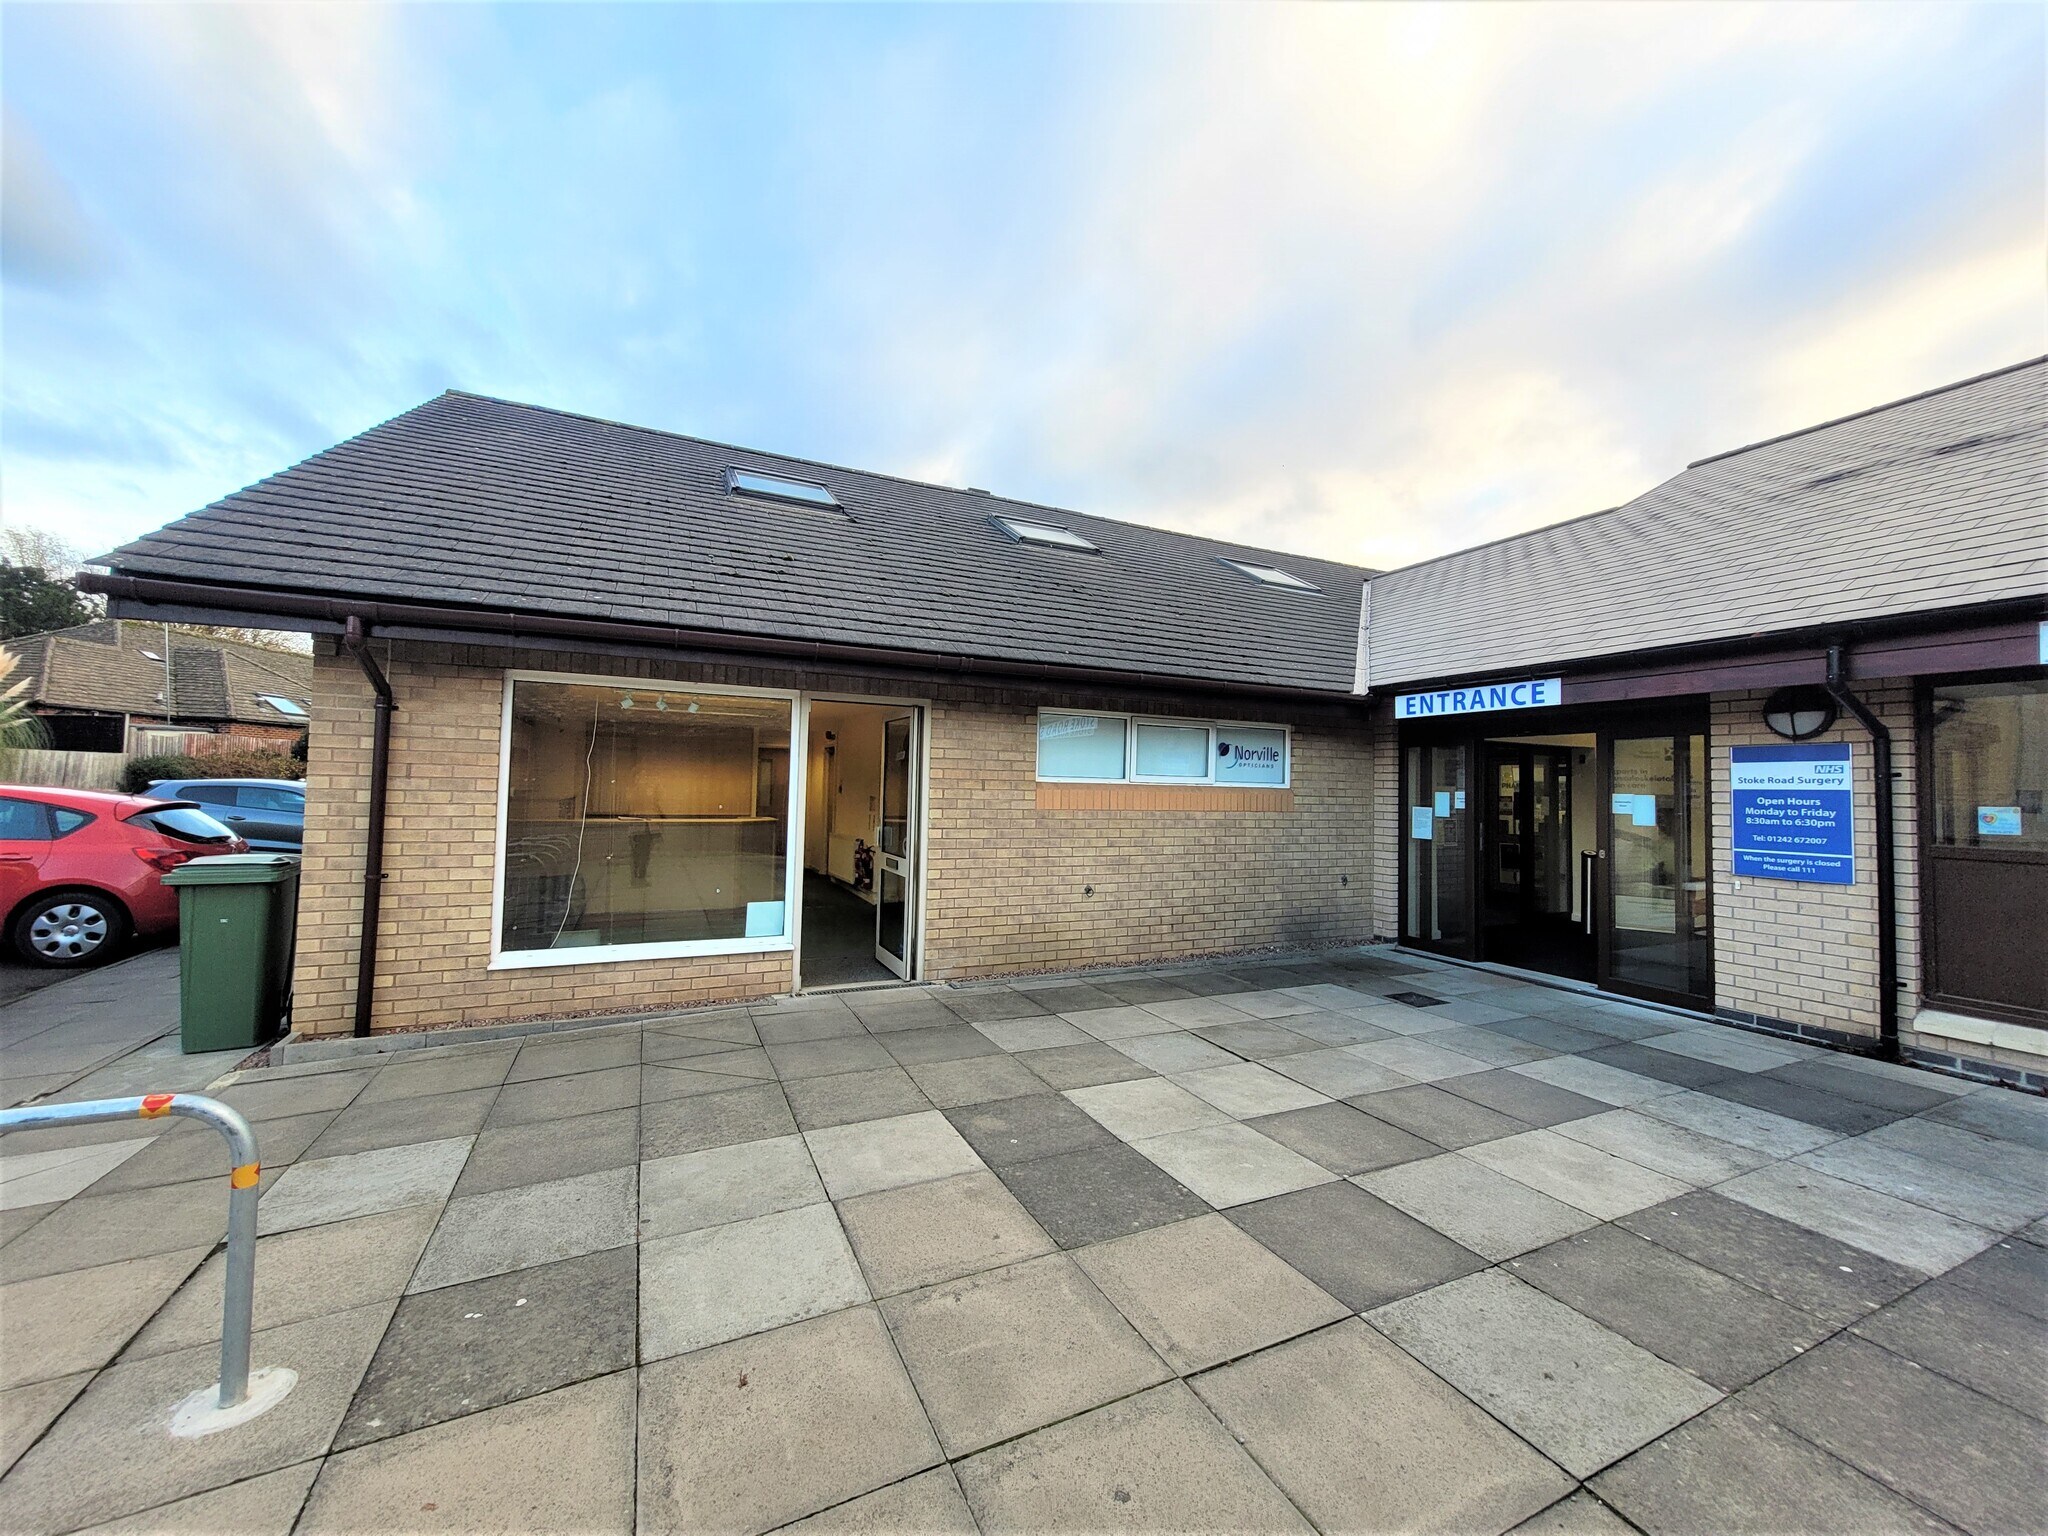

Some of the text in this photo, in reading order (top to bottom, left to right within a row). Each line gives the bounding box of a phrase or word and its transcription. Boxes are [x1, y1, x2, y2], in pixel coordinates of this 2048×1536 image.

[1406, 683, 1545, 715] ENTRANCE
[1234, 745, 1279, 761] Norville
[1815, 765, 1843, 774] NHS
[1738, 776, 1844, 786] Stoke Road Surgery
[1757, 797, 1821, 806] Open Hours
[1745, 807, 1785, 817] Monday
[1801, 808, 1837, 818] Friday
[1746, 817, 1780, 825] 8:30am
[1795, 819, 1836, 828] 6:30pm
[1766, 835, 1793, 843] 01242
[1794, 837, 1827, 845] 672007
[1776, 858, 1805, 866] surgery
[1814, 860, 1841, 868] closed
